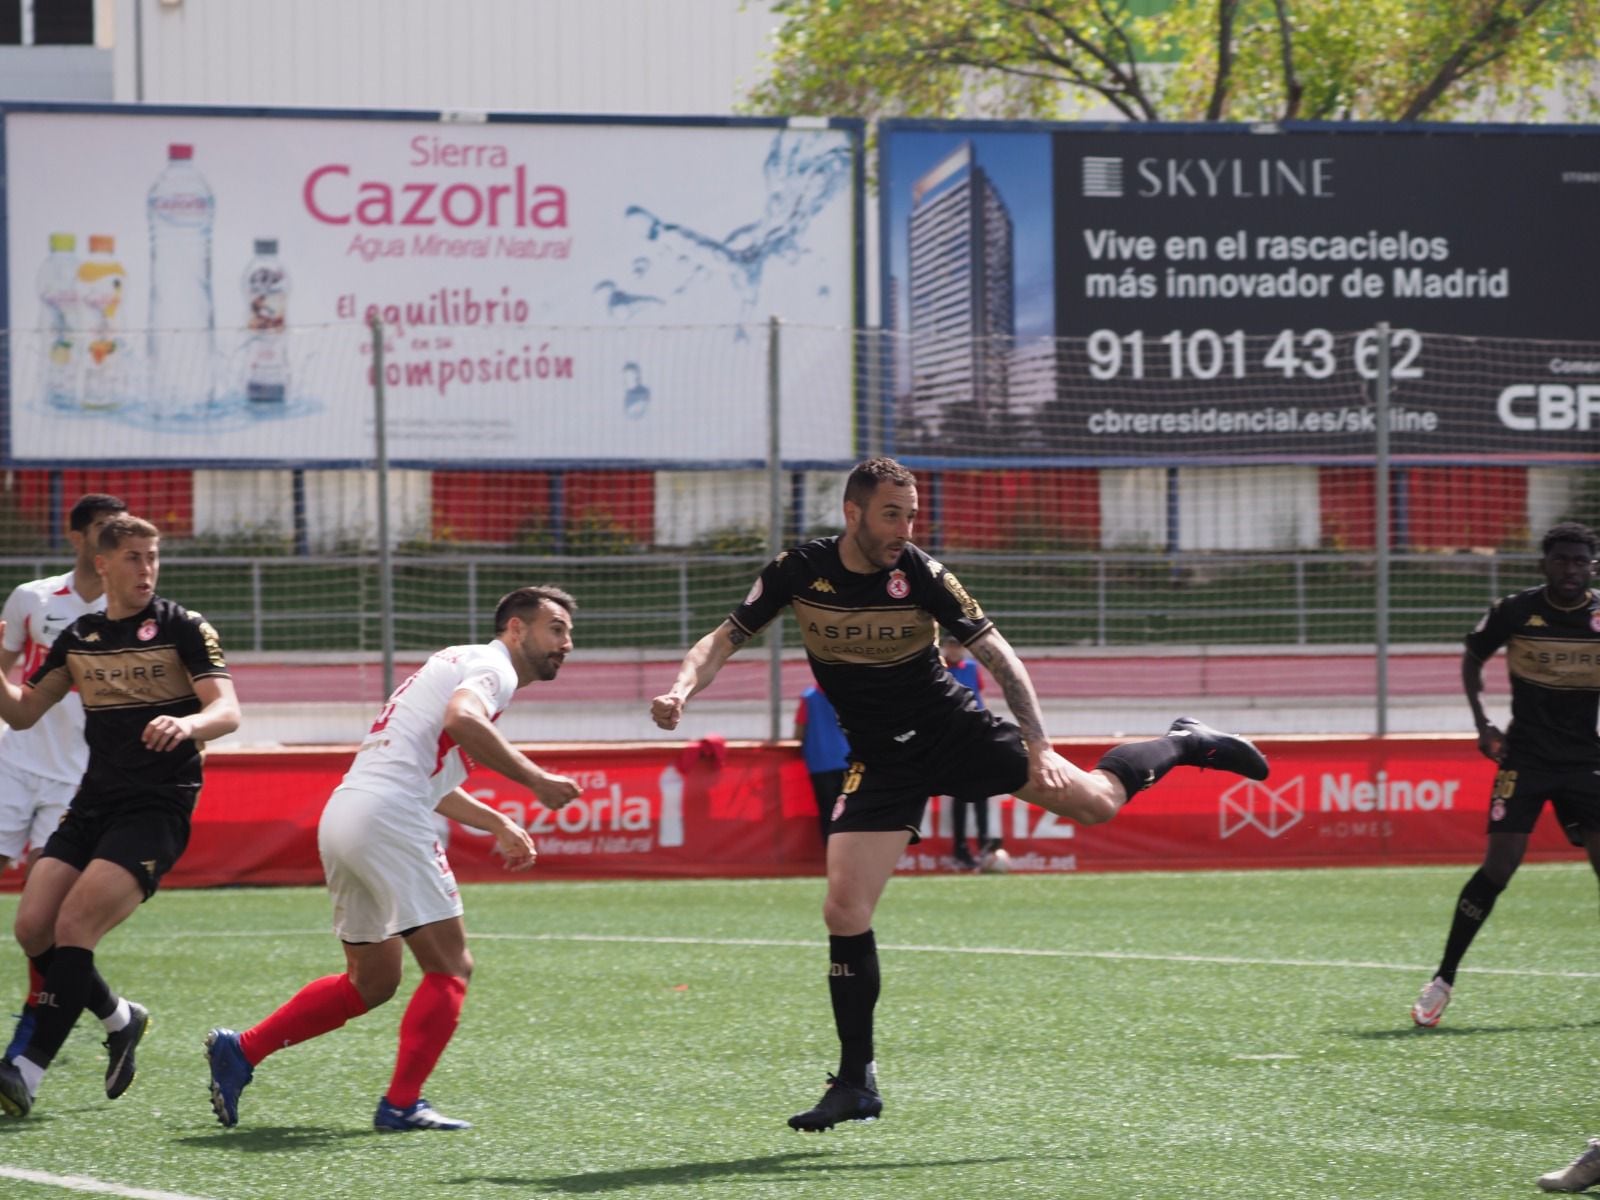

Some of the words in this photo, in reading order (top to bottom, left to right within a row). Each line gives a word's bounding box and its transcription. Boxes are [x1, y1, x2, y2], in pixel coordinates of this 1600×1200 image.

[409, 135, 508, 168] Sierra
[1138, 157, 1335, 197] SKYLINE
[303, 163, 568, 229] Cazorla
[346, 233, 406, 262] Agua
[411, 233, 492, 259] Mineral
[497, 234, 574, 260] Natural
[1083, 229, 1157, 260] Vive
[1164, 235, 1208, 260] en
[1215, 229, 1247, 260] el
[1256, 229, 1450, 261] rascacielos
[1086, 266, 1157, 298] más
[1166, 266, 1334, 298] innovador
[1341, 266, 1384, 298] de
[1393, 266, 1510, 298] Madrid
[336, 293, 356, 319] El
[364, 286, 530, 339] equilibrio
[1086, 328, 1145, 380] 91
[1160, 328, 1247, 380] 101
[1263, 328, 1337, 380] 43
[1354, 328, 1425, 380] 62
[1087, 407, 1440, 433] cbreresidencial.es/skline
[83, 663, 167, 682] ASPIRE
[1320, 770, 1460, 813] Neinor
[1319, 821, 1394, 839] HOMES
